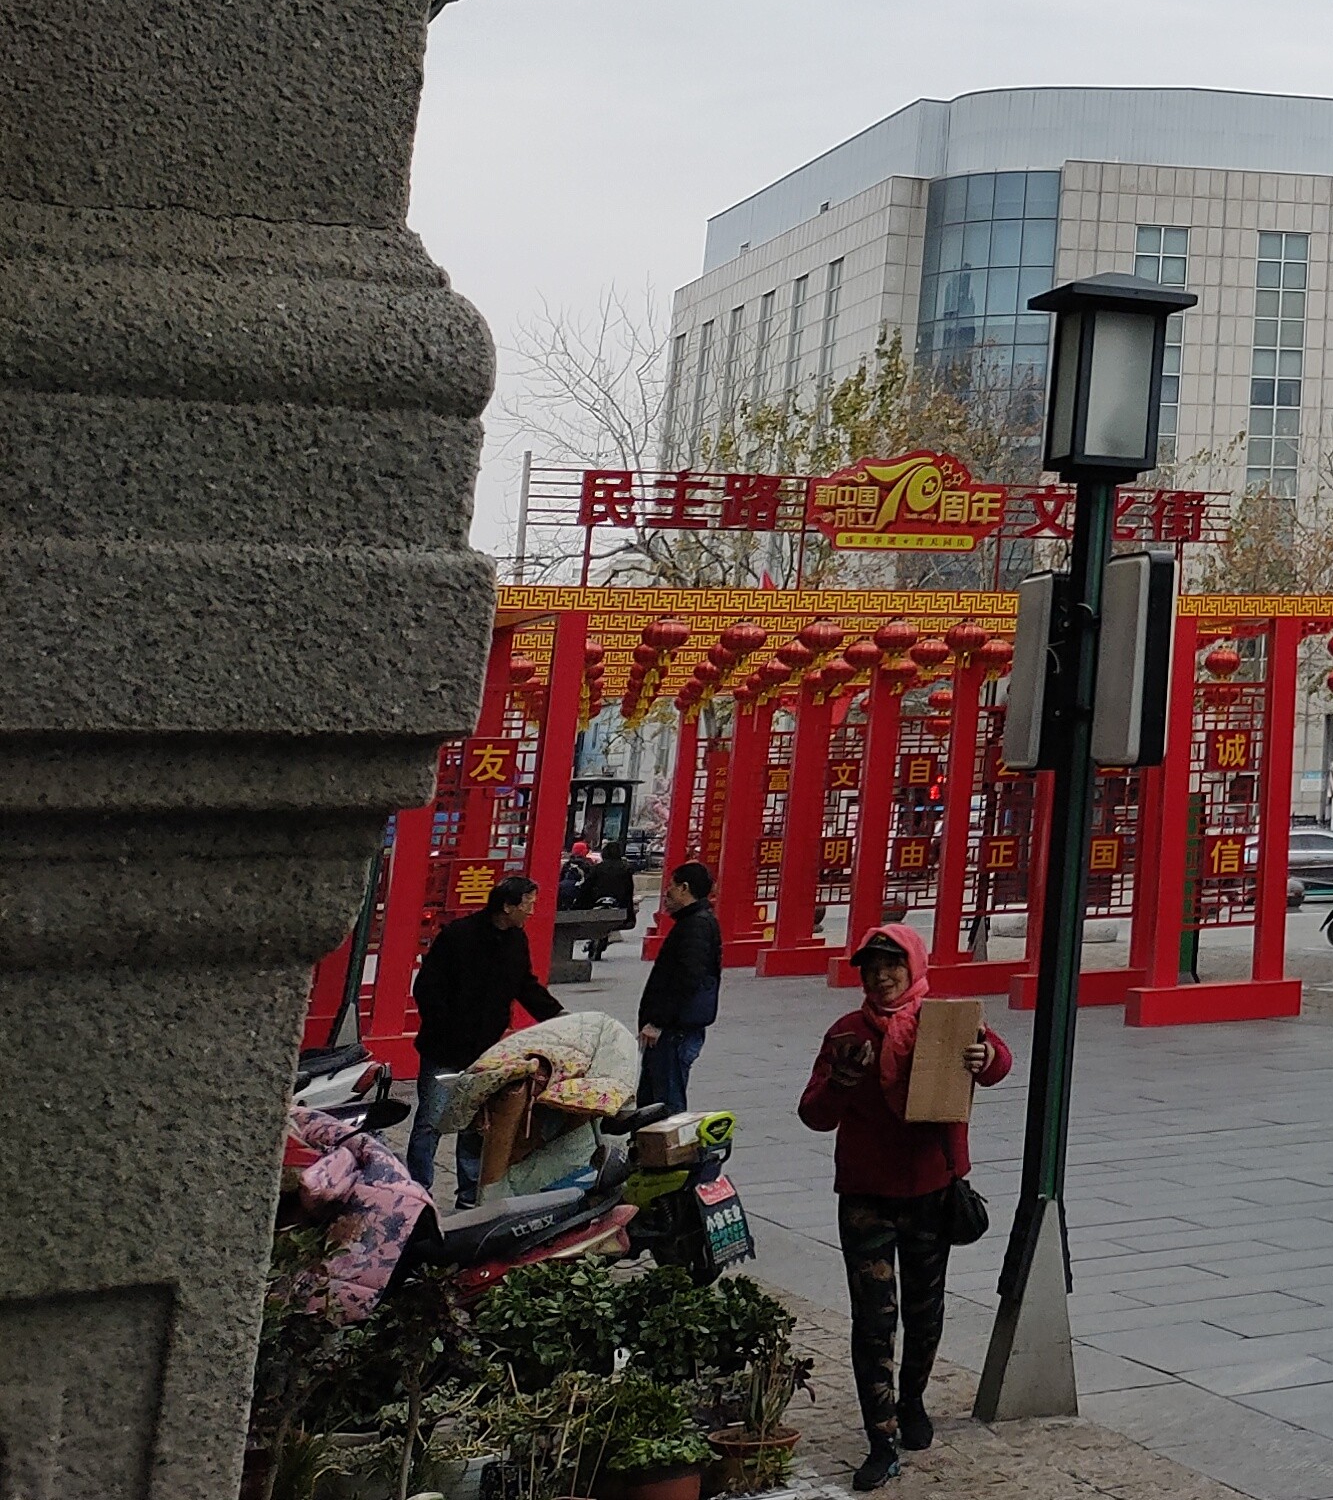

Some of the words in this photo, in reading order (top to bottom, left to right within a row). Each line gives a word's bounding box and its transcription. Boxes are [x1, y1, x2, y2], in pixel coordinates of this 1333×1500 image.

[577, 470, 781, 529] 民主路
[814, 484, 880, 508] 新中国
[834, 507, 879, 530] 成立
[938, 490, 1002, 525] 周年
[455, 744, 511, 905] 友善
[760, 767, 791, 865] 富强
[824, 762, 857, 865] 文明
[901, 757, 932, 868] 自由
[1210, 733, 1248, 874] 诚信
